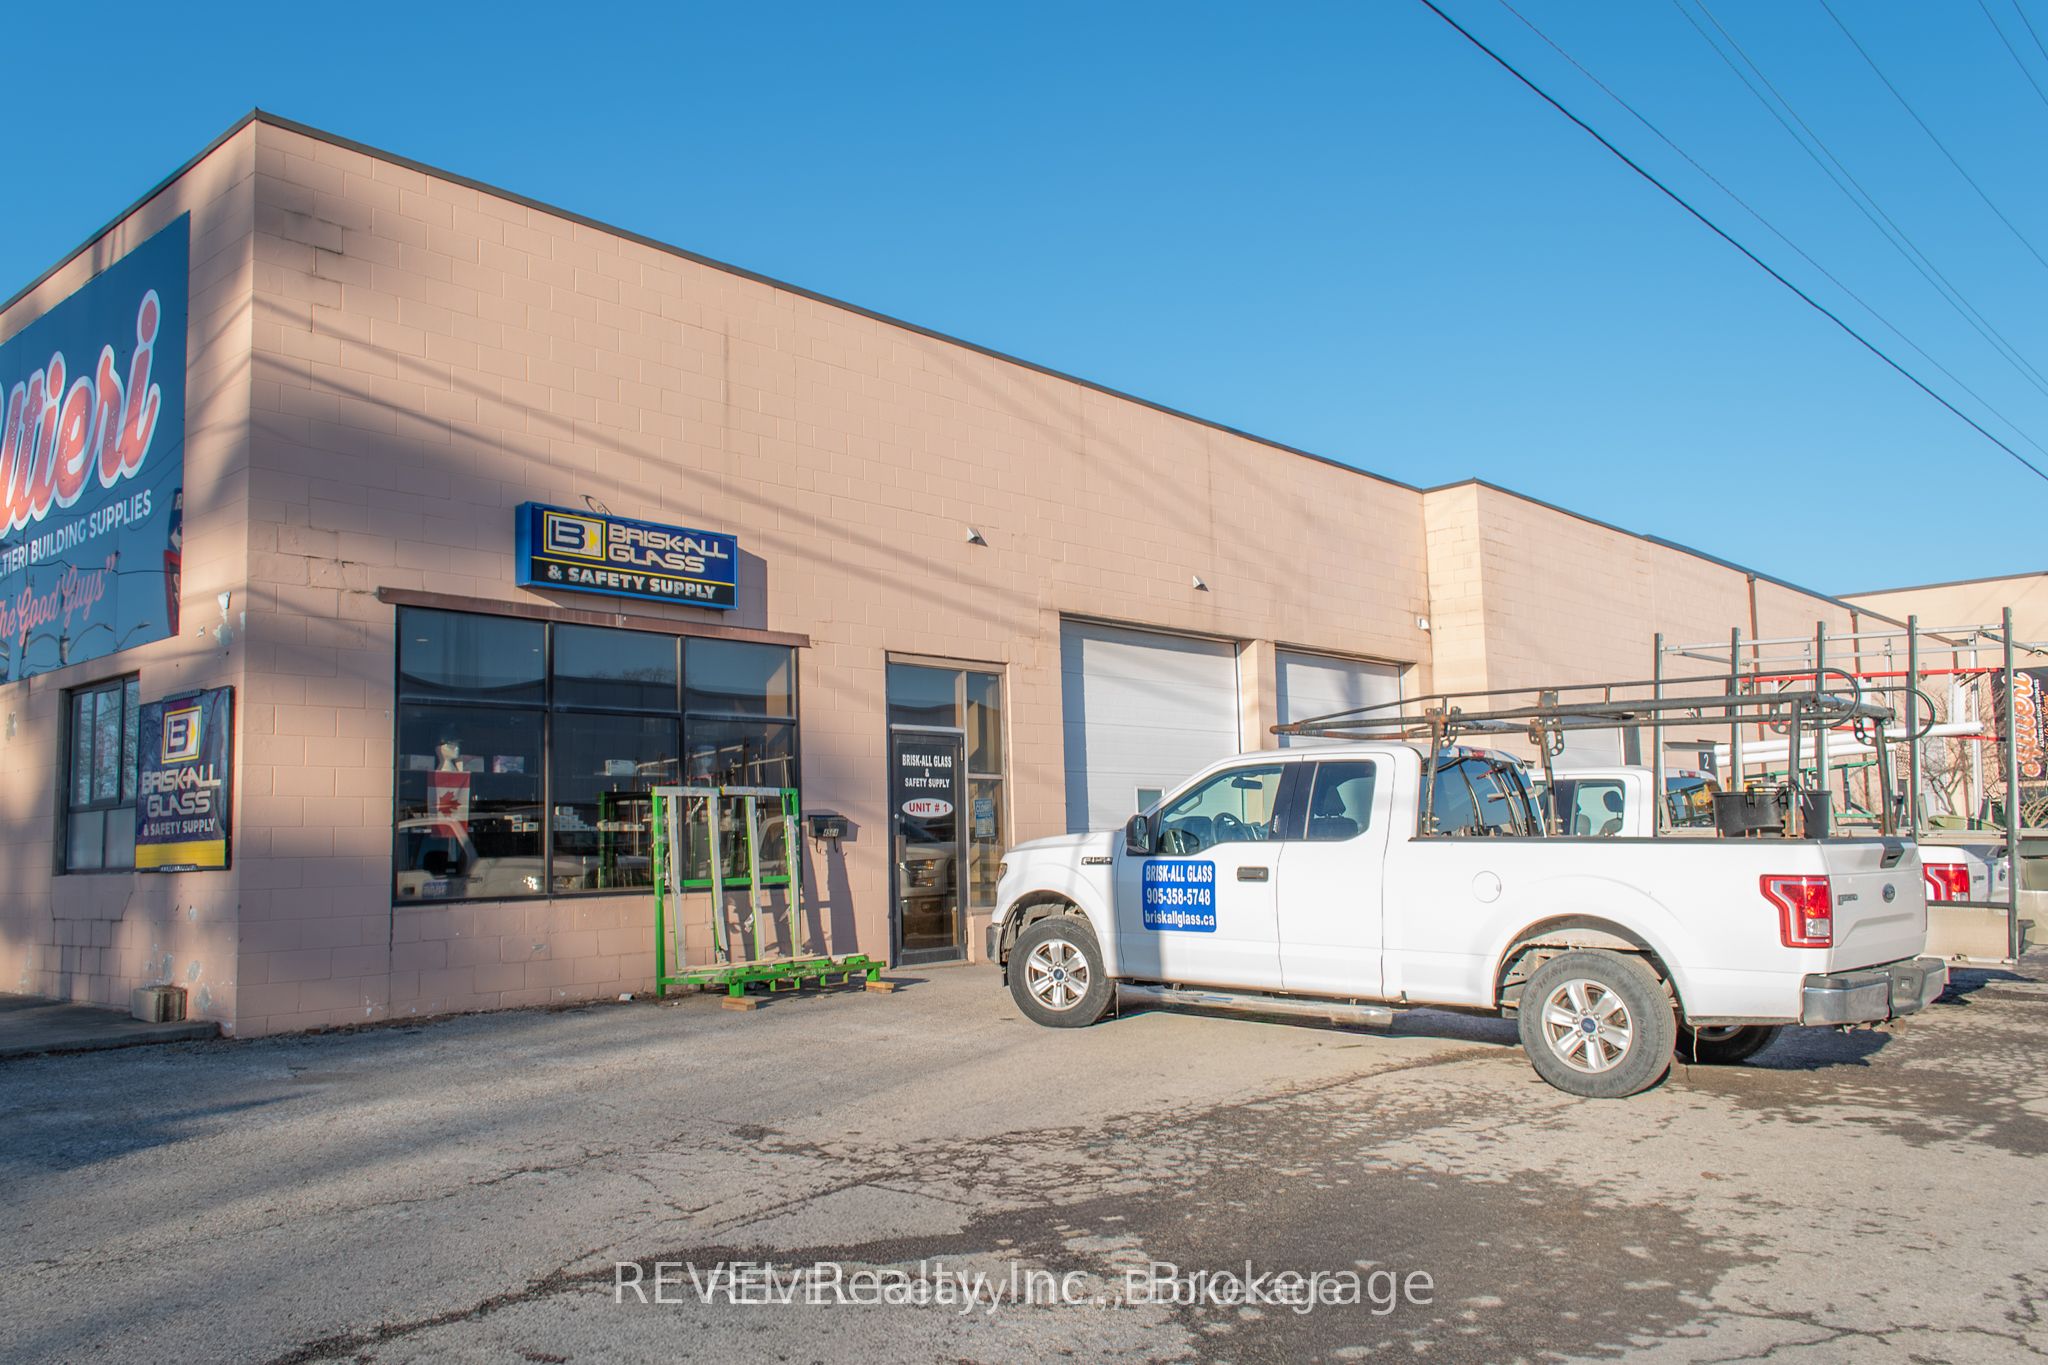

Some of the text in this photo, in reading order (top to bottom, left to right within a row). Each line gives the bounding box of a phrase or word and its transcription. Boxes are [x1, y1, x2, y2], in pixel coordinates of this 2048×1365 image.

[0, 288, 161, 541] ltieri
[31, 519, 87, 564] BUILDING
[89, 489, 152, 539] SUPPLIES
[608, 523, 729, 560] BRISK-ALL
[608, 543, 705, 574] GLASS
[548, 565, 717, 600] & SAFETY SUPPLY
[17, 580, 61, 647] Good
[902, 754, 952, 768] BRISK-ALL GLASS
[142, 764, 221, 795] BRISK-ALL
[904, 778, 950, 788] SAFETY SUPPLY
[147, 790, 211, 818] GLASS
[909, 802, 948, 813] UNIT # 1
[143, 818, 216, 836] & SAFETY SUPPLY
[1145, 864, 1213, 883] BRISK-ALL GLASS
[1146, 887, 1211, 906] 905-358-5748
[1145, 910, 1215, 928] briskallglass.ca
